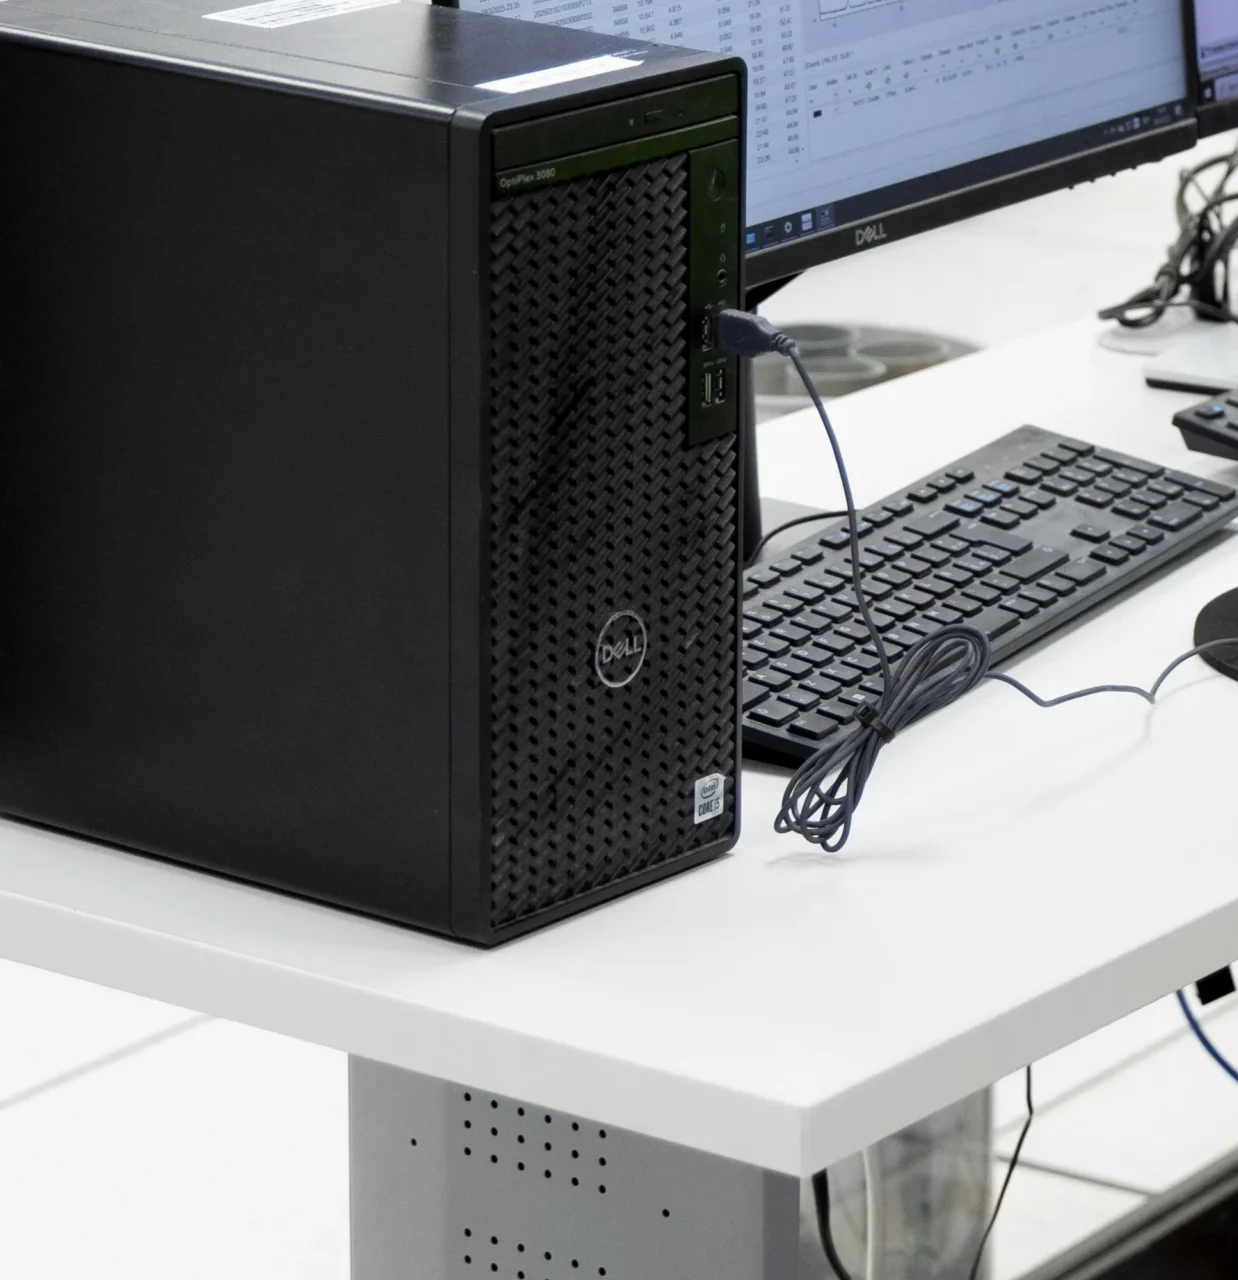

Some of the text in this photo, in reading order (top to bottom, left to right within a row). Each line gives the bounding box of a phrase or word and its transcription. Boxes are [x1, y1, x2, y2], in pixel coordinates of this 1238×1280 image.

[500, 168, 556, 189] OptiPlex 3080
[855, 222, 887, 246] DELL
[602, 635, 642, 664] DELL
[698, 800, 713, 817] CORE
